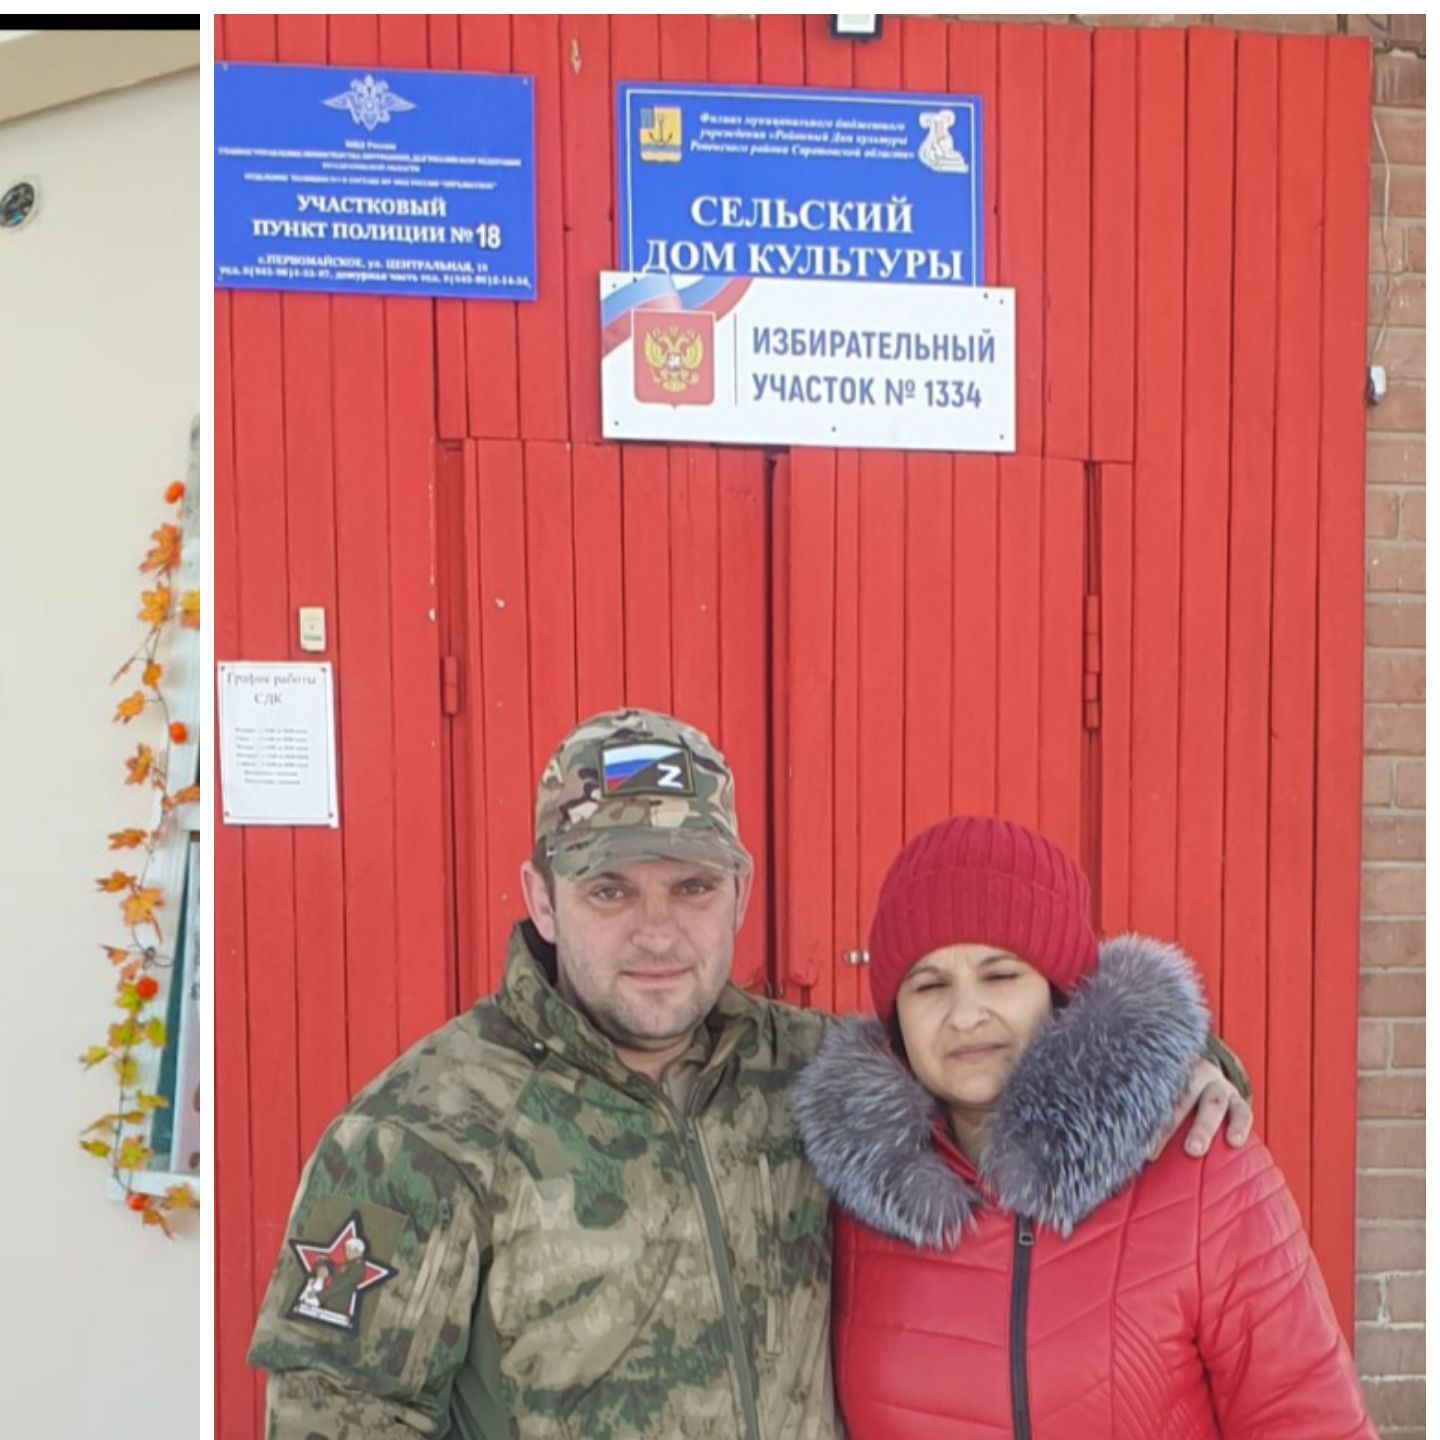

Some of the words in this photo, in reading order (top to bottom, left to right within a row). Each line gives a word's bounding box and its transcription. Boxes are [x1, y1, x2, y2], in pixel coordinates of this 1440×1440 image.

[297, 194, 447, 217] УЧАСТКОВЫЙ
[690, 194, 913, 233] СЕЛЬСКИЙ
[252, 219, 328, 239] ПУНКТ
[333, 221, 446, 243] ПОЛИЦИИ
[476, 223, 501, 249] 18
[642, 238, 737, 273] ДОМ
[747, 242, 963, 279] КУЛЬТУРЫ
[753, 326, 995, 363] ИЗБИРАТЕЛЬНЫЙ
[752, 372, 876, 406] УЧАСТОК
[885, 378, 916, 406] №
[924, 379, 982, 409] 1334
[657, 763, 684, 789] Z
